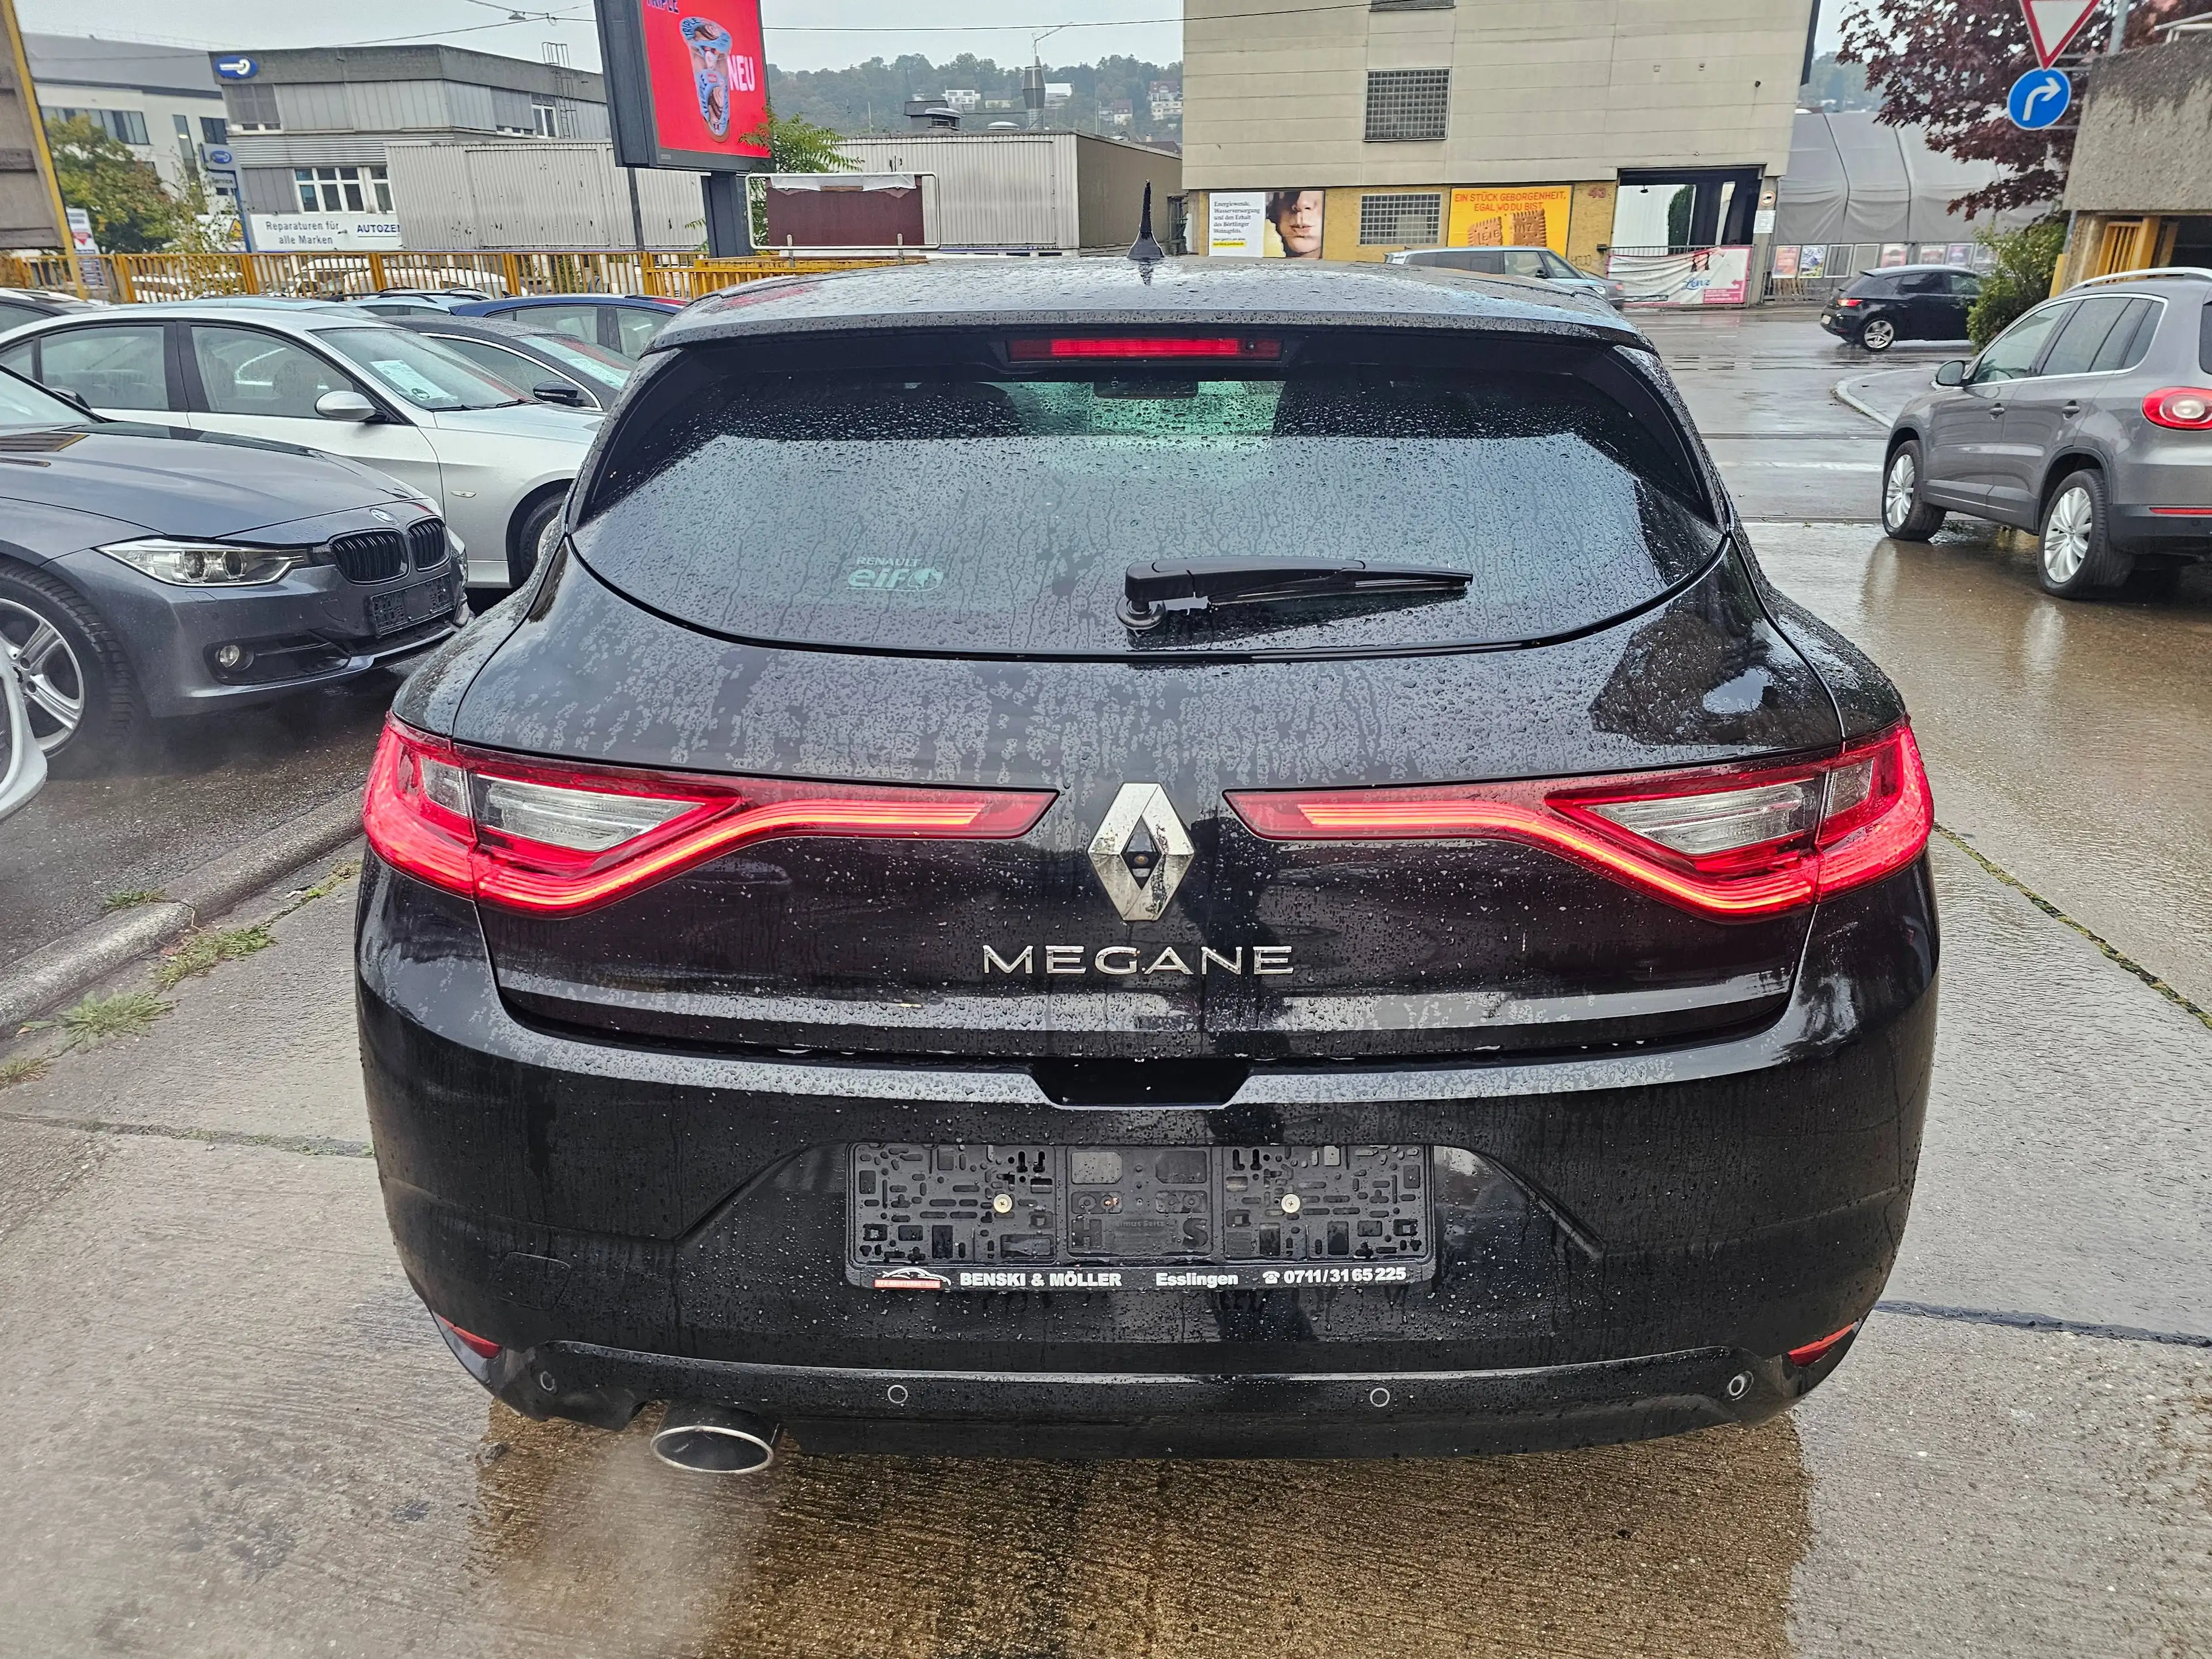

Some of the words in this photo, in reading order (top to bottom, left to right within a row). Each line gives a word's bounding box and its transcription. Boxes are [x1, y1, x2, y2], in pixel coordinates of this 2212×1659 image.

[727, 54, 755, 92] NEU
[1455, 193, 1468, 202] EIN
[1469, 191, 1498, 201] STÜCK
[1500, 191, 1566, 200] GEBORGENHEIT,
[1512, 203, 1522, 211] DU
[1525, 202, 1543, 210] BIST
[266, 222, 323, 231] Reparaturen
[326, 221, 339, 230] für
[279, 235, 295, 244] alle
[299, 236, 333, 244] Marken
[1681, 276, 1710, 290] Lenz
[857, 557, 923, 567] RENAULT
[847, 567, 910, 588] elf
[982, 945, 1294, 975] MEGANE
[960, 1272, 1026, 1286] BENSKI
[1031, 1274, 1044, 1286] &
[1050, 1271, 1122, 1287] MÖLLER
[1156, 1272, 1238, 1289] Esslingen
